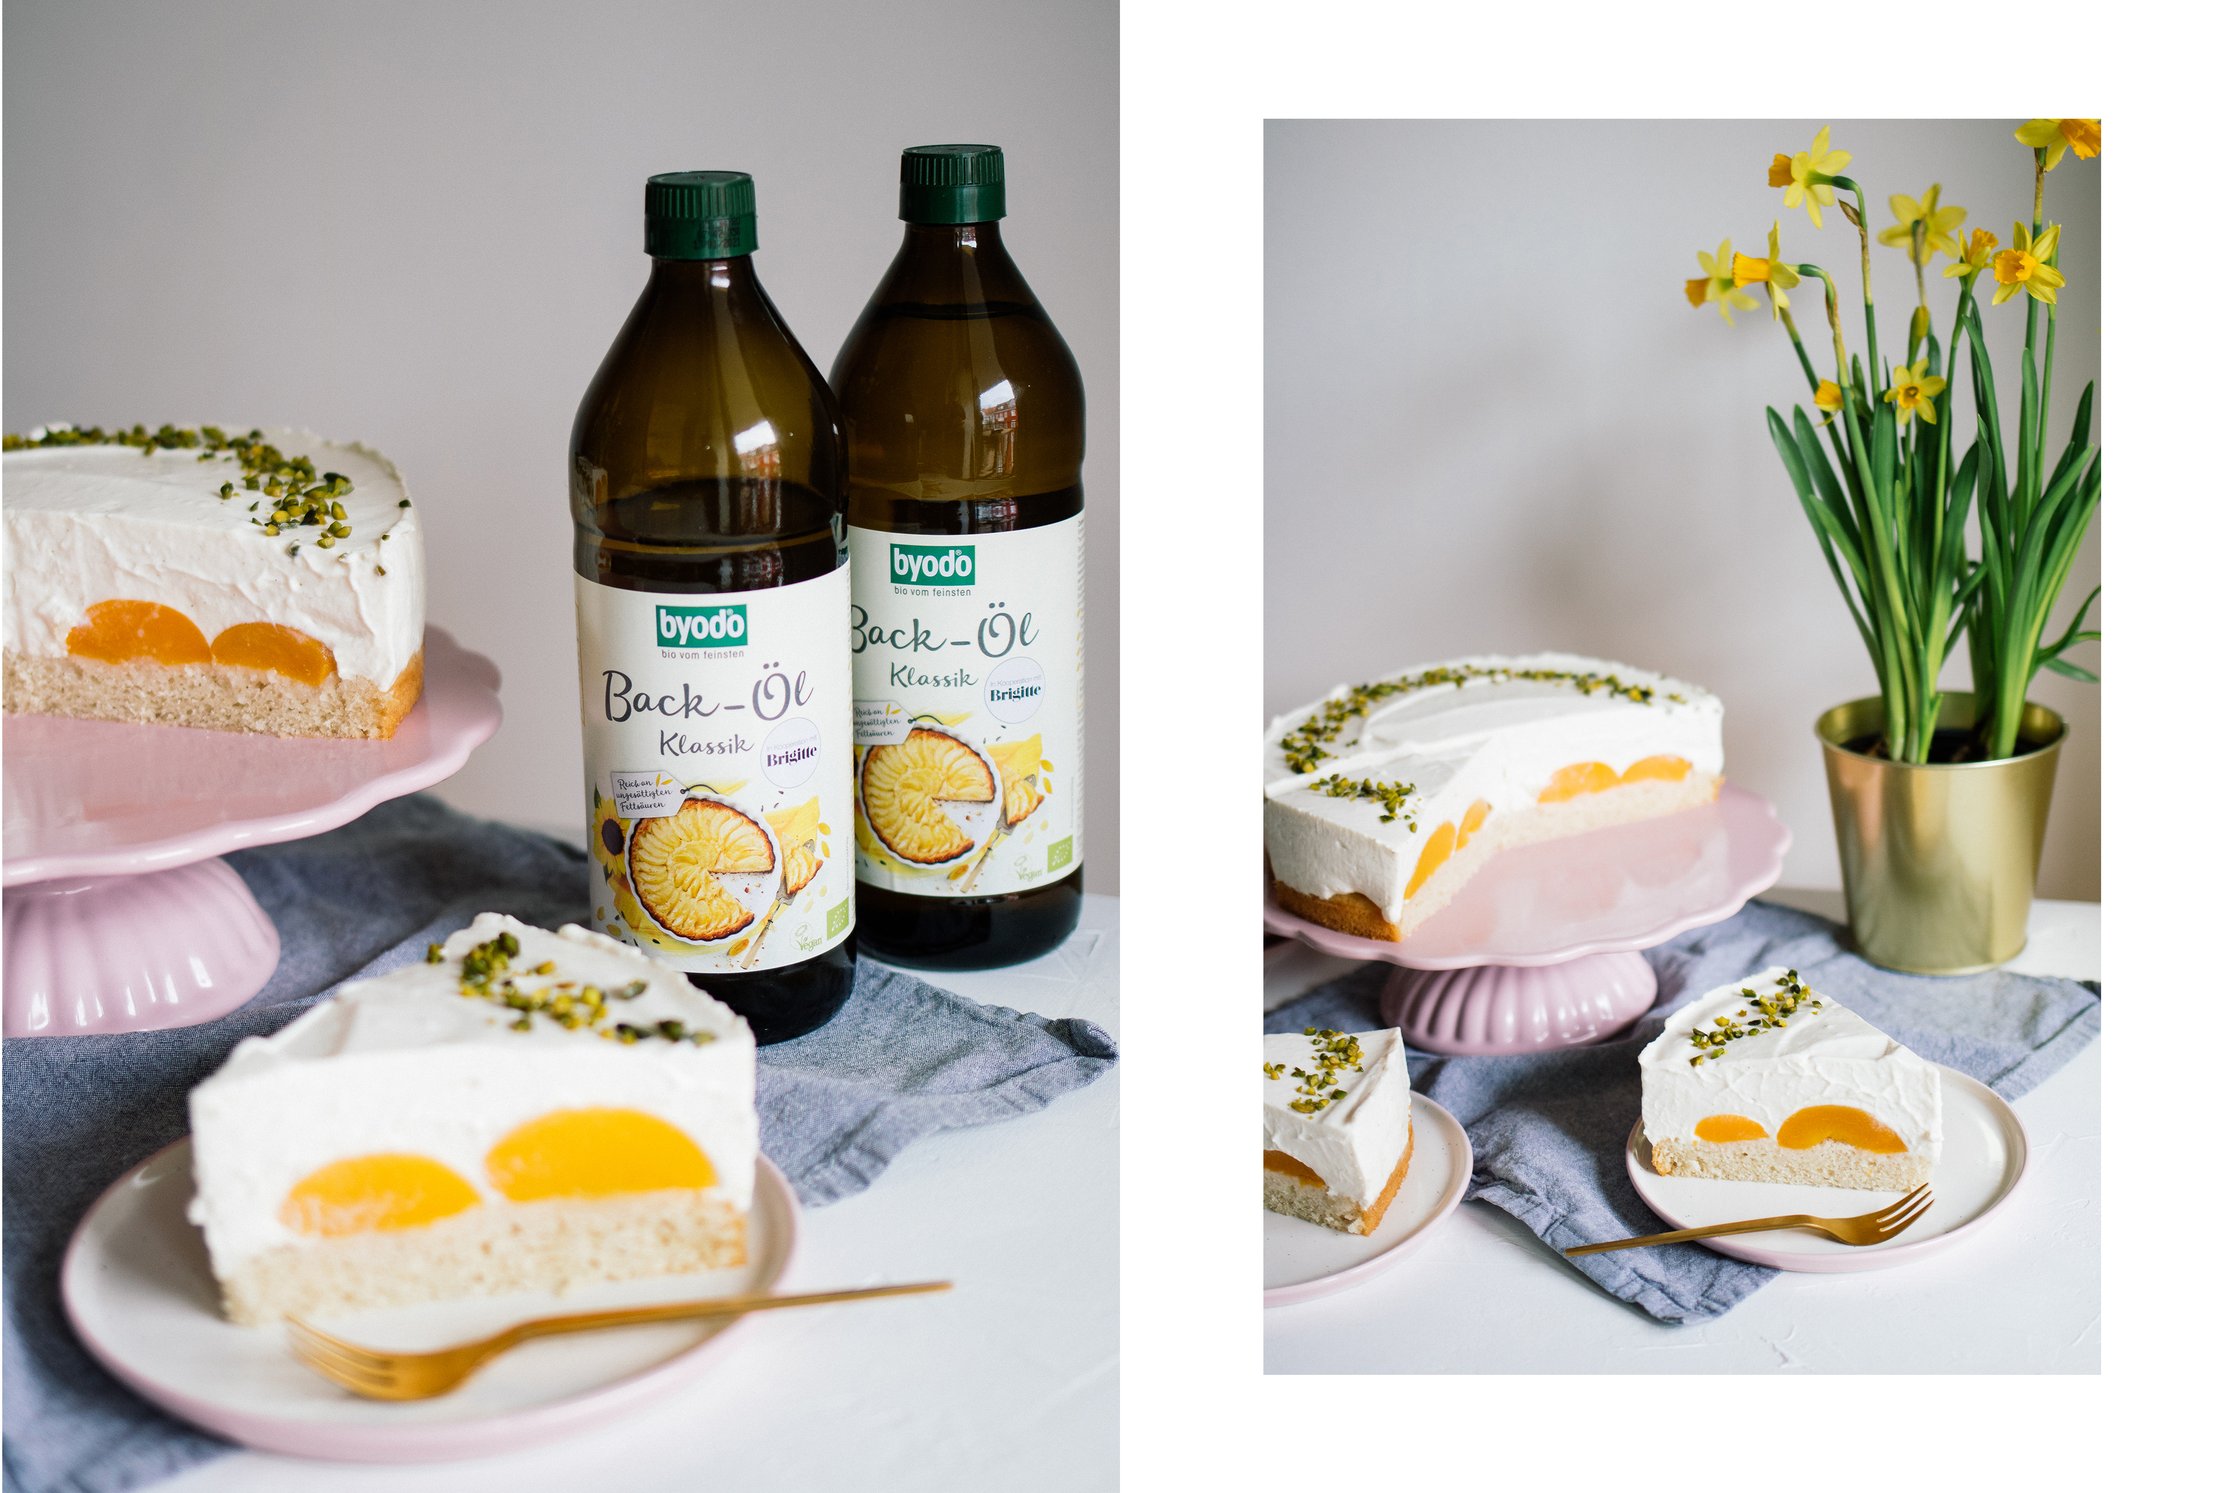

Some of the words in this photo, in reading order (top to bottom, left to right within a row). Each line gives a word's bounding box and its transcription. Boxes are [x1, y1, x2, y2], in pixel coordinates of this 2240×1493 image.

[893, 547, 973, 582] byodo
[894, 586, 908, 595] bio
[911, 588, 929, 597] vom
[933, 588, 972, 597] feinsten
[659, 608, 745, 645] byodo
[661, 650, 677, 659] bio
[679, 651, 700, 660] vom
[703, 650, 745, 660] feinsten
[890, 662, 979, 688] Klassik
[990, 685, 1041, 702] Brigitte
[660, 729, 755, 757] Klassik
[767, 746, 817, 767] Brigitte
[617, 778, 640, 790] Reich
[641, 779, 654, 787] an
[616, 788, 672, 801] ungesättigten
[620, 801, 666, 812] Fettsäuren
